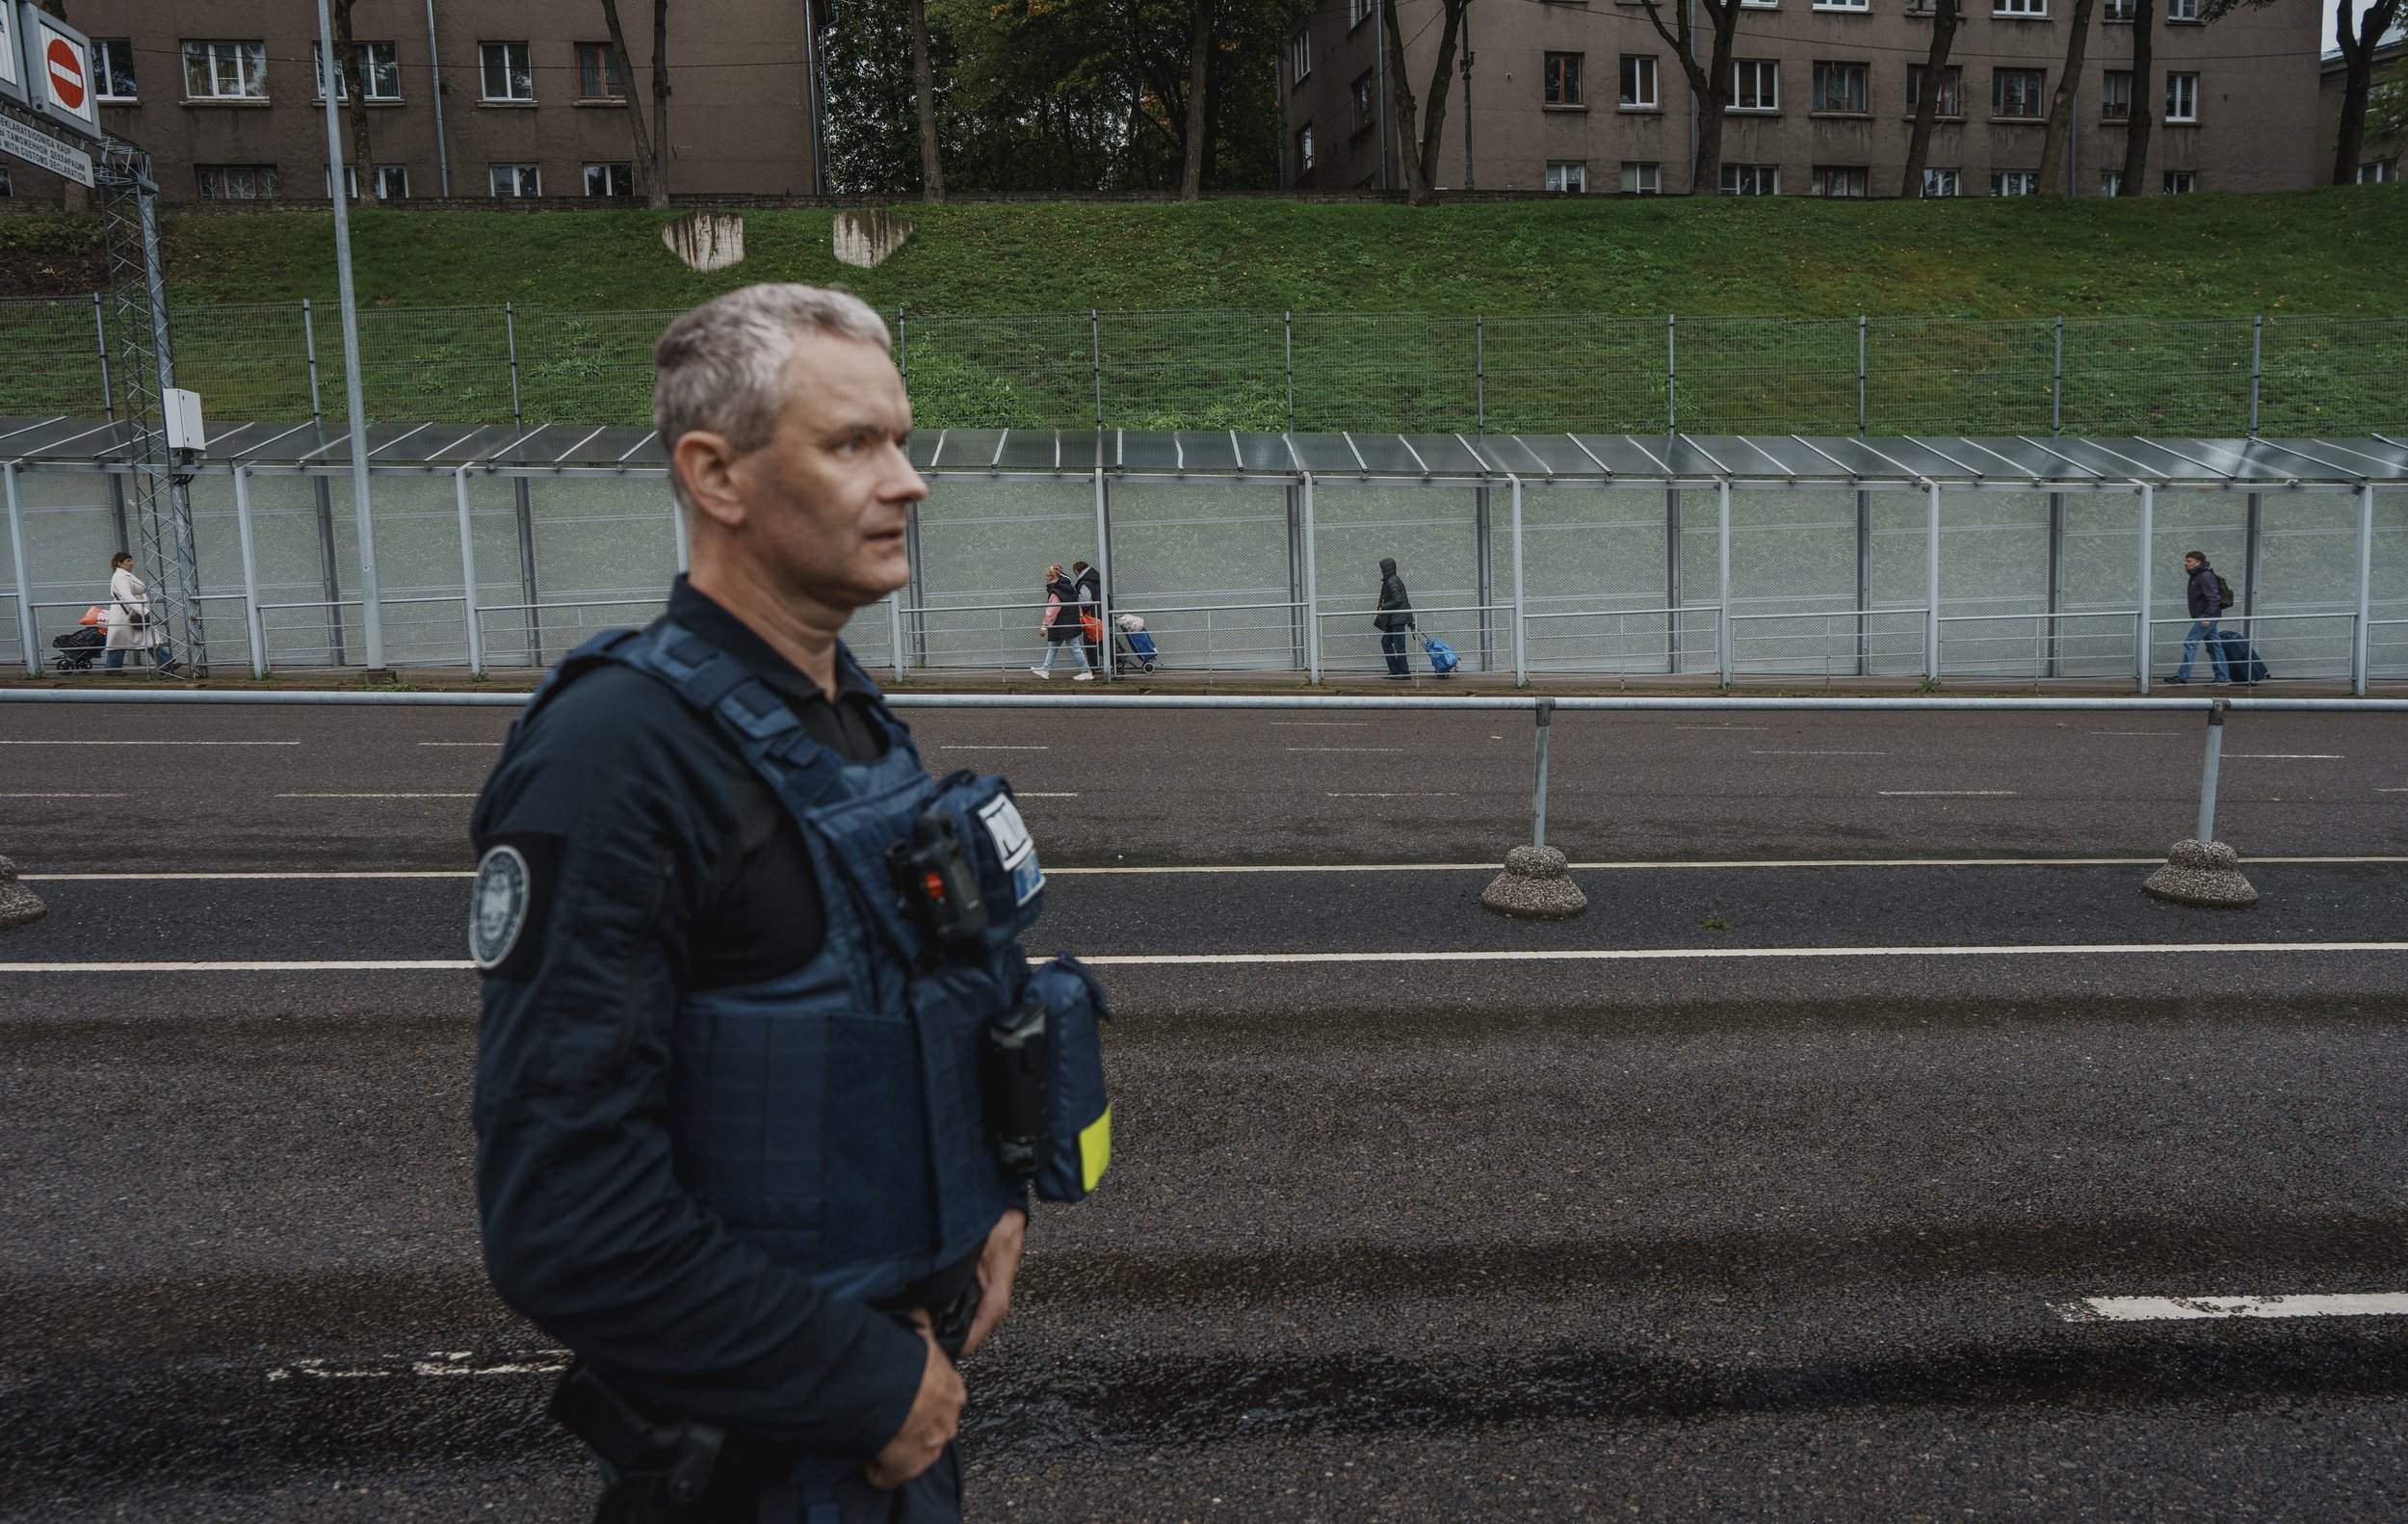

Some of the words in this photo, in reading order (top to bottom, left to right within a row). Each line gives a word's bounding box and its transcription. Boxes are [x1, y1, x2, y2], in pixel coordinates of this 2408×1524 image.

[0, 117, 55, 148] EKLARATSIOONIGA
[20, 145, 48, 166] CUSTOMS
[49, 160, 87, 182] DECLARATION
